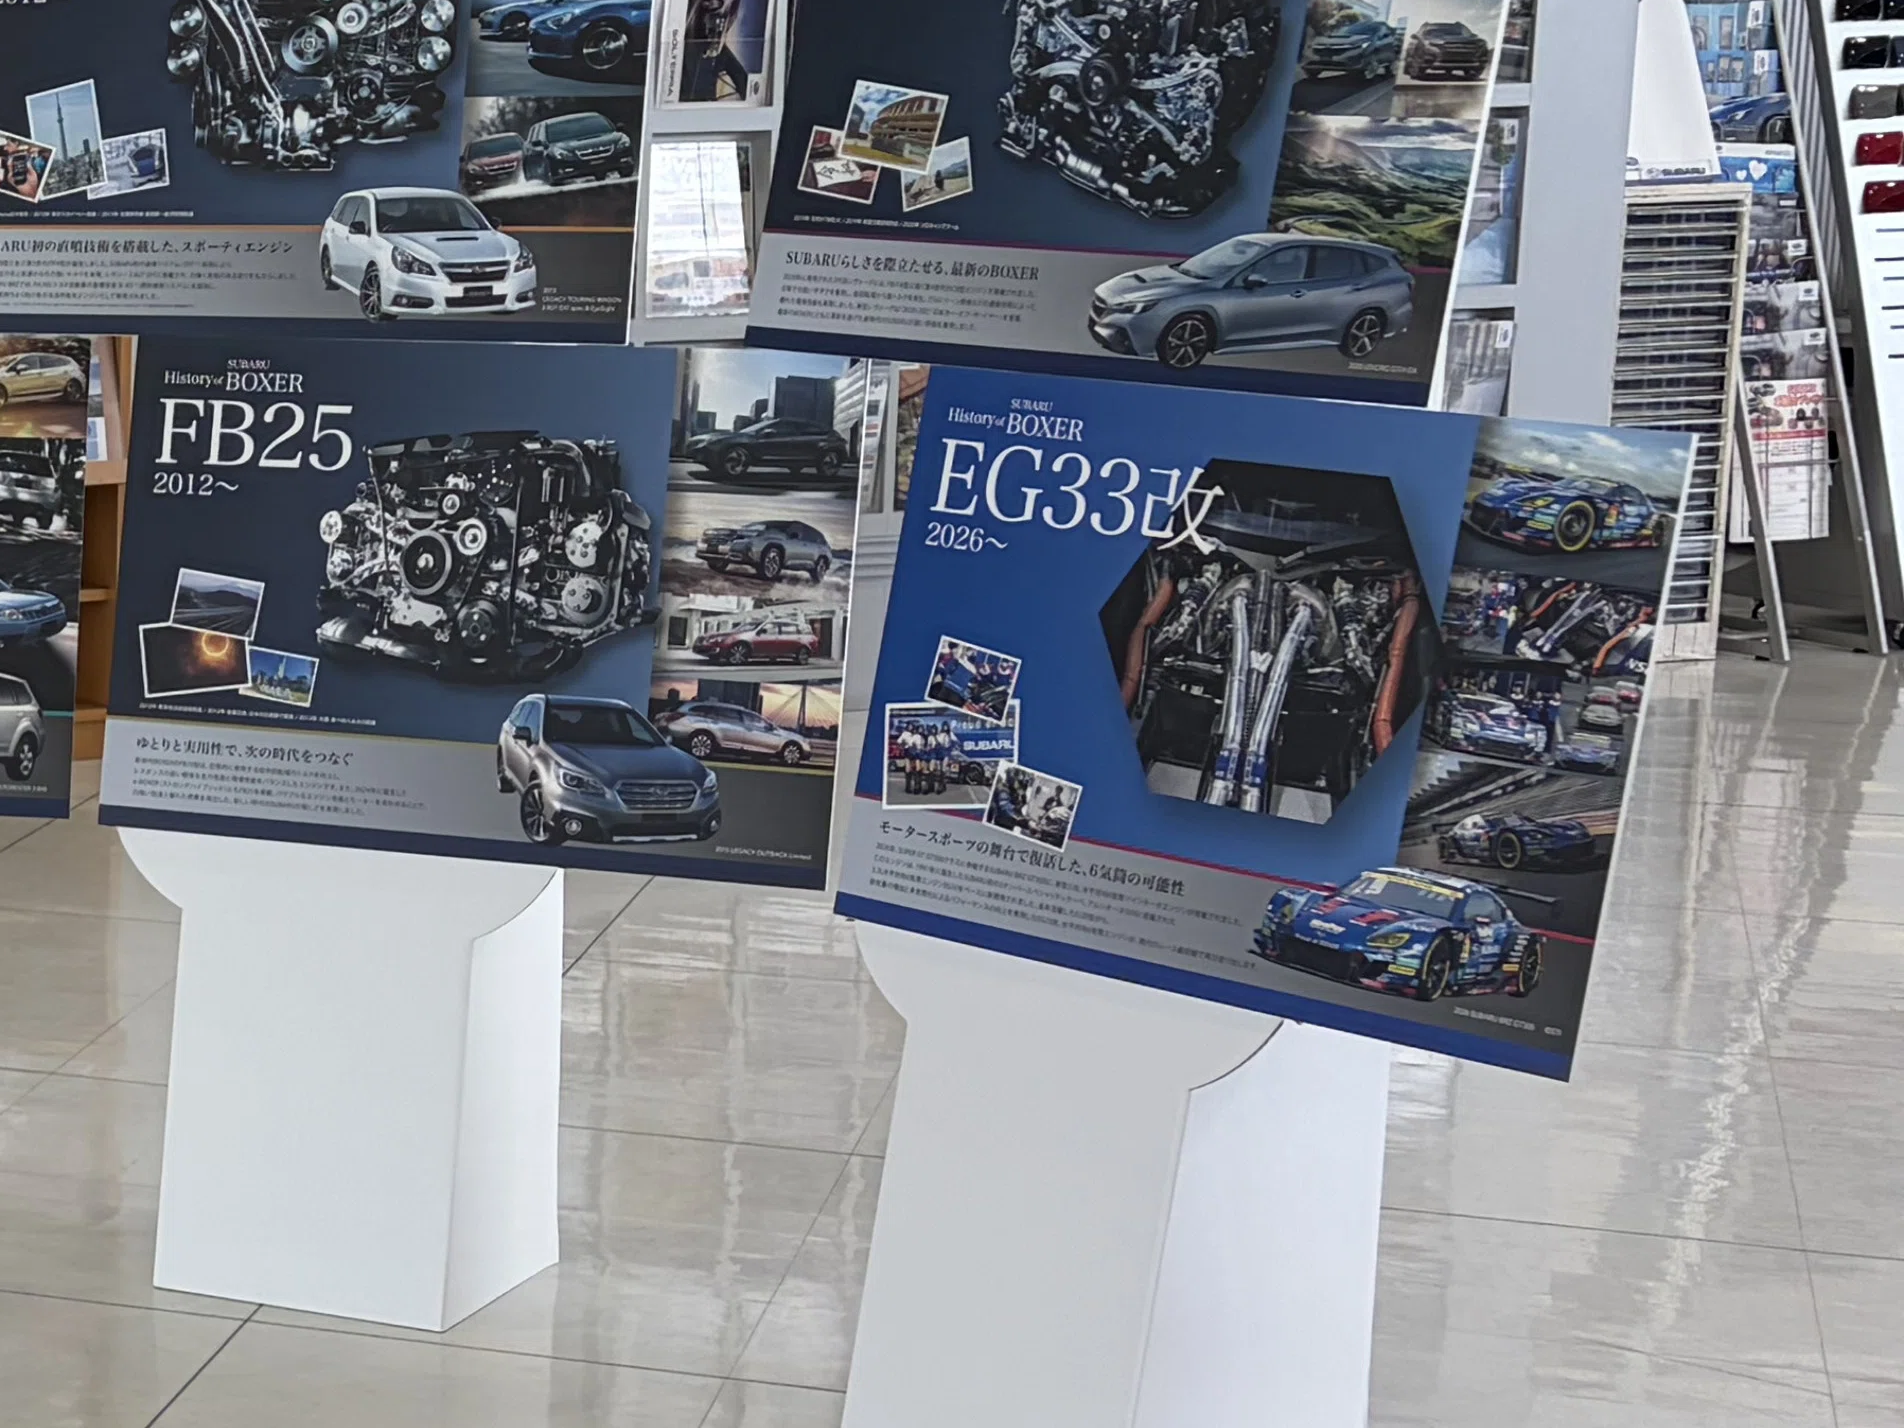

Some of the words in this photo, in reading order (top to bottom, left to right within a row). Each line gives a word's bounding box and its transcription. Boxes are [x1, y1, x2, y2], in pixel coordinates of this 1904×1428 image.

[164, 370, 213, 388] History
[213, 376, 224, 385] of
[225, 371, 304, 393] BOXER
[155, 398, 353, 471] FB25
[948, 406, 995, 429] History
[995, 415, 1007, 428] of
[1006, 412, 1085, 442] BOXER
[929, 437, 1225, 555] EG33改
